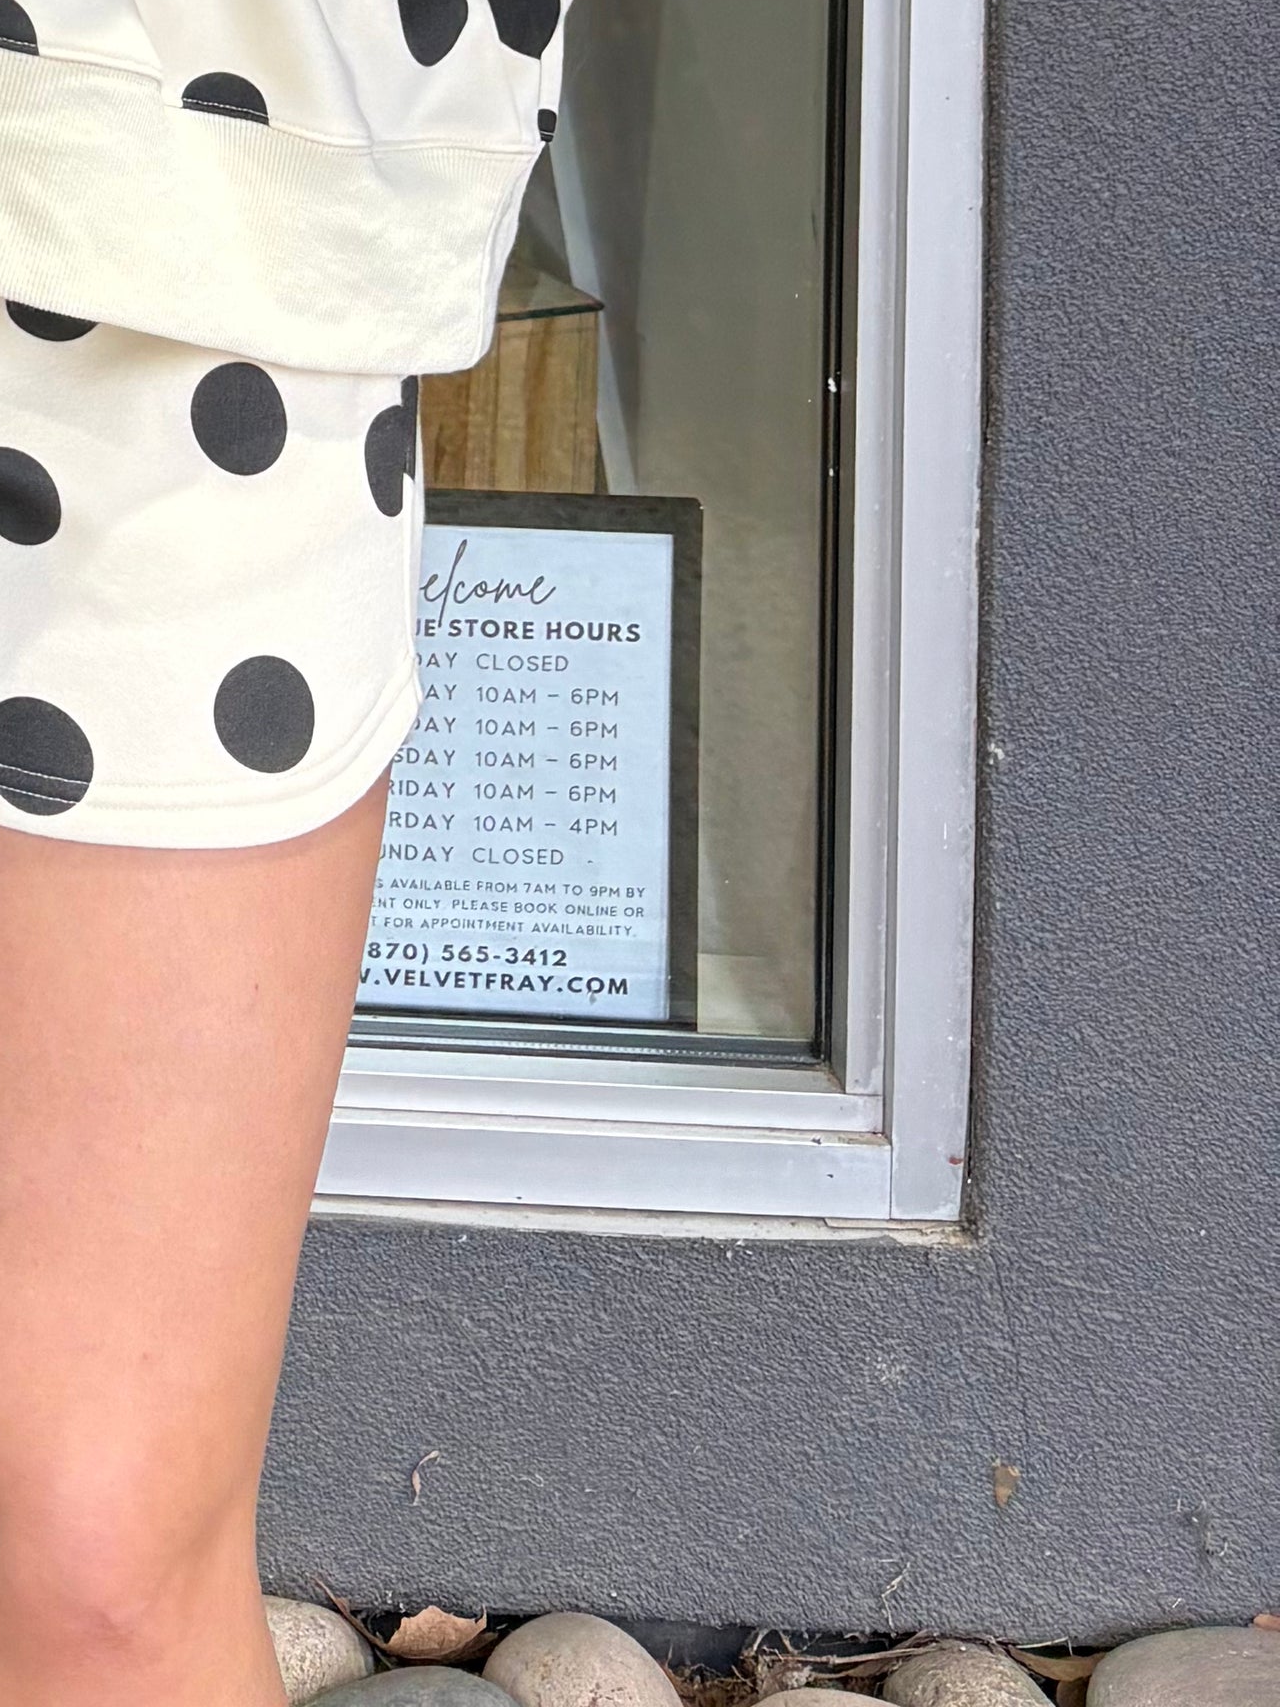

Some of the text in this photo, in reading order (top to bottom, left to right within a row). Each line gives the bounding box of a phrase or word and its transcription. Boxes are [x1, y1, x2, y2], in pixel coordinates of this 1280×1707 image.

[447, 618, 535, 640] STORE
[545, 621, 641, 643] HOURS
[476, 653, 569, 672] CLOSED
[477, 686, 537, 704] 10AM
[570, 688, 619, 706] 6PM
[414, 716, 457, 734] AY
[475, 718, 536, 736] 10AM
[569, 720, 618, 739] 6PM
[474, 750, 535, 768] 10AM
[568, 753, 617, 771] 6PM
[474, 782, 534, 800] 10AM
[568, 785, 617, 804] 6PM
[473, 815, 533, 832] 10AM
[568, 818, 618, 836] 4PM
[472, 847, 564, 865] CLOSED
[390, 878, 471, 891] AVAILABLE
[476, 881, 518, 893] FROM
[523, 882, 556, 895] 7AM
[562, 884, 583, 896] TO
[589, 885, 621, 898] 9PM
[625, 887, 646, 899] BY
[452, 900, 509, 913] PLEASE
[514, 902, 557, 915] BOOK
[565, 904, 618, 917] ONLINE
[623, 906, 645, 918] OR
[384, 916, 414, 929] FOR
[420, 918, 525, 933] APPOINTMENT
[440, 944, 568, 967] 565-3412
